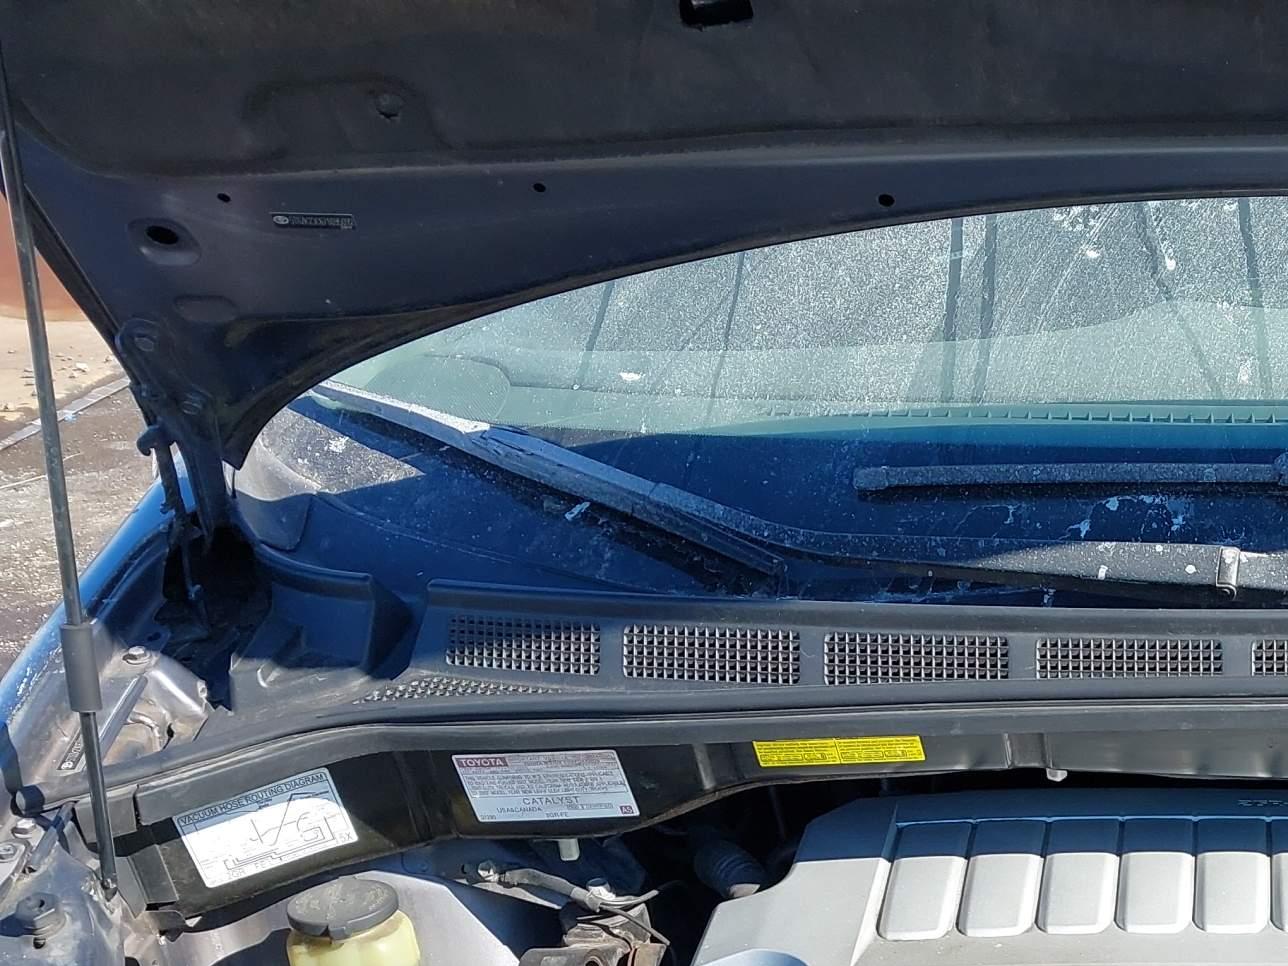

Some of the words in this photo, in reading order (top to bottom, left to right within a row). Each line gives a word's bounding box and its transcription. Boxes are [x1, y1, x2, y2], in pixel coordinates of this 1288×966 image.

[459, 757, 504, 768] TOYOTA
[179, 807, 220, 825] VACUUM
[219, 799, 246, 814] HOSE
[245, 785, 285, 804] ROUTING
[284, 774, 324, 791] DIAGRAM
[522, 795, 580, 806] CATALYST
